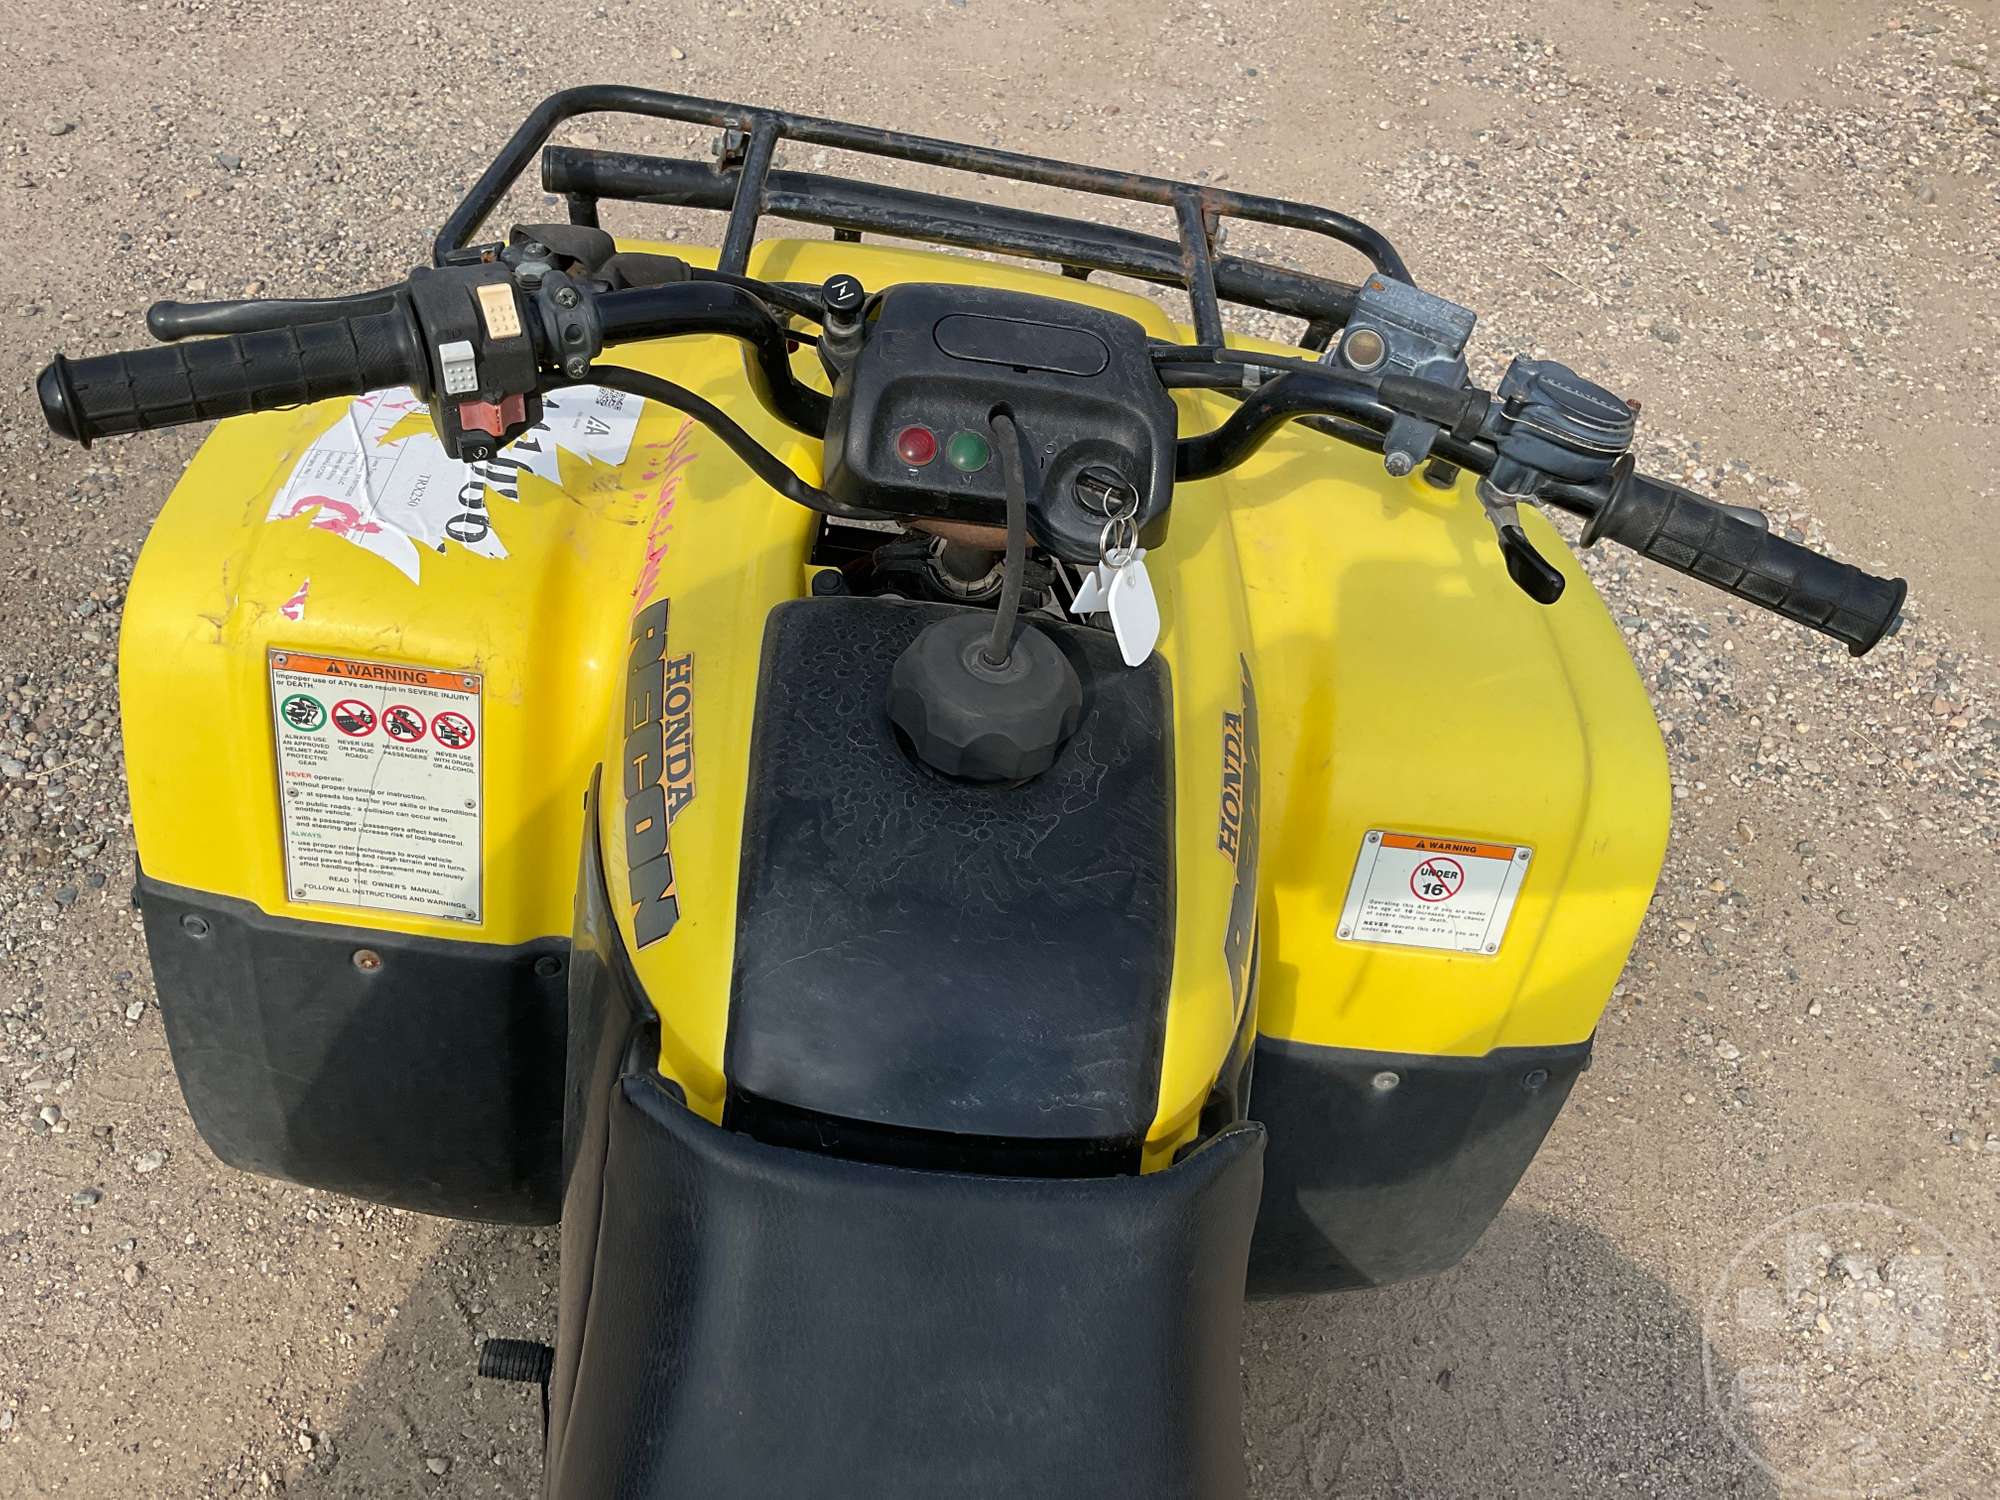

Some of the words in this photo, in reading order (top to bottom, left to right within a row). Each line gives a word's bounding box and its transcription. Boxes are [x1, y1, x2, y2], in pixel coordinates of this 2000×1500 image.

[408, 472, 432, 508] TRX250
[345, 663, 428, 684] WARNING
[276, 671, 310, 681] Improper
[375, 684, 396, 692] result
[408, 688, 439, 697] SEVERE
[441, 693, 469, 701] INJURY
[665, 653, 693, 823] HONDA
[294, 741, 329, 749] APPROVED
[349, 746, 374, 754] PUBLIC
[287, 753, 327, 761] PROTECTIVE
[383, 750, 427, 760] PASSENGERS
[436, 751, 458, 759] NEVER
[451, 759, 474, 768] DRUGS
[285, 771, 312, 779] NEVER
[624, 598, 680, 950] RECON
[348, 786, 375, 795] training
[1218, 711, 1242, 863] HONDA
[1429, 842, 1477, 853] WARNING
[1421, 867, 1458, 879] UNDER
[329, 875, 350, 883] READ
[304, 883, 335, 891] FOLLOW
[352, 889, 407, 900] INSTRUCTIONS
[409, 895, 425, 903] AND
[1423, 883, 1445, 896] 16
